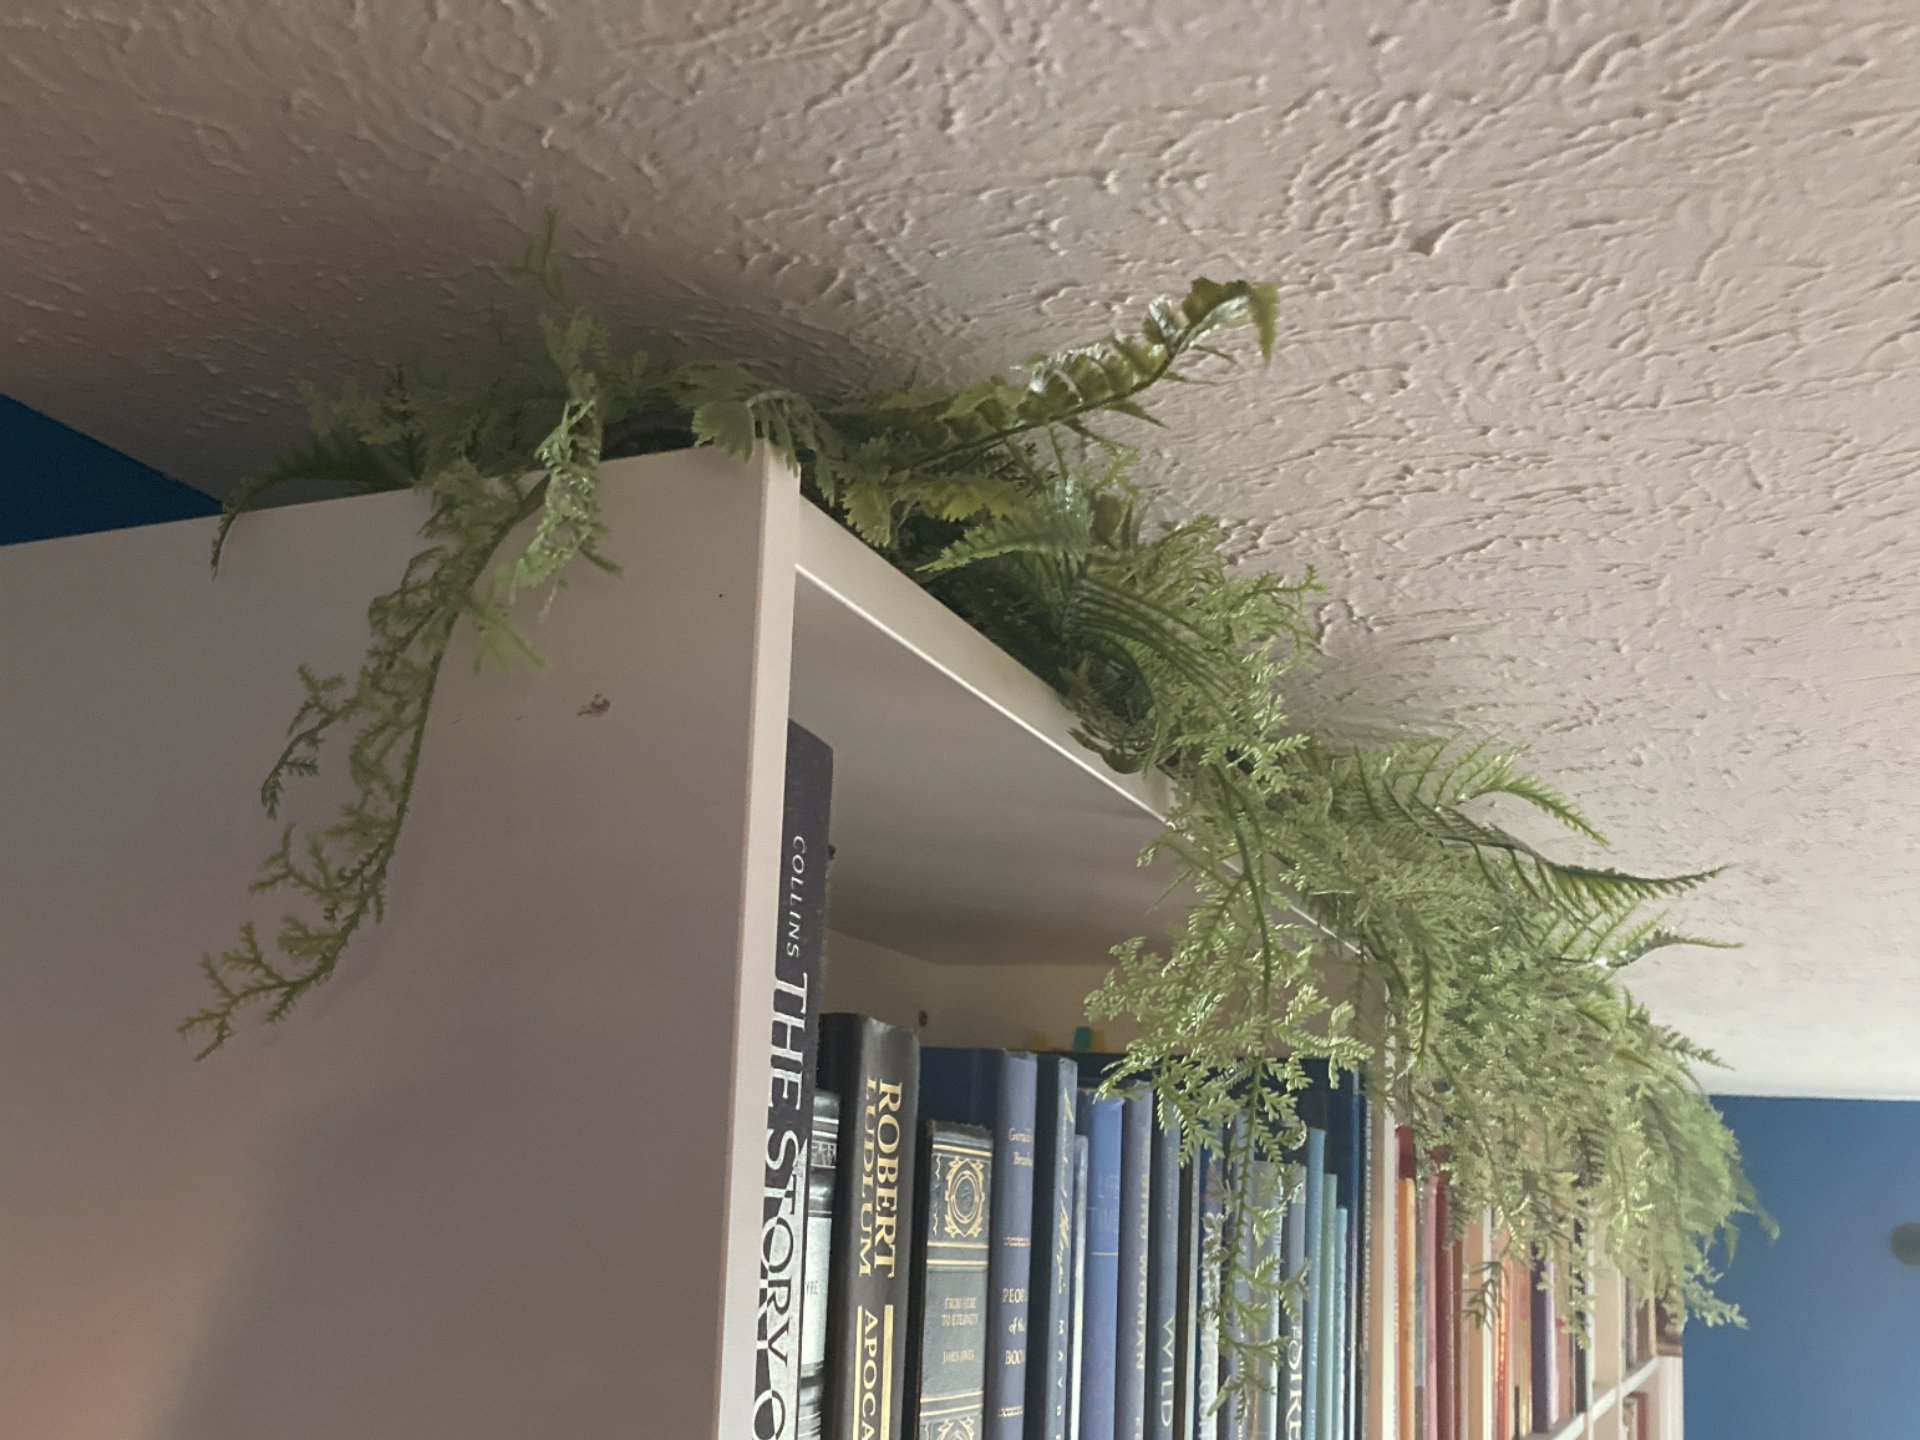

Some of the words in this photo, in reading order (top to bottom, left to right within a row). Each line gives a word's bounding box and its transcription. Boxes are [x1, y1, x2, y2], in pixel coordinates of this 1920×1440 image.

[787, 835, 806, 958] COLLINS
[768, 972, 808, 1110] THE
[859, 1077, 877, 1277] LUDLUM
[874, 1079, 902, 1278] ROBERT
[757, 1128, 800, 1367] STORY
[1136, 1253, 1147, 1369] WOMAN
[862, 1309, 878, 1440] APOCA
[1161, 1314, 1174, 1426] WILD
